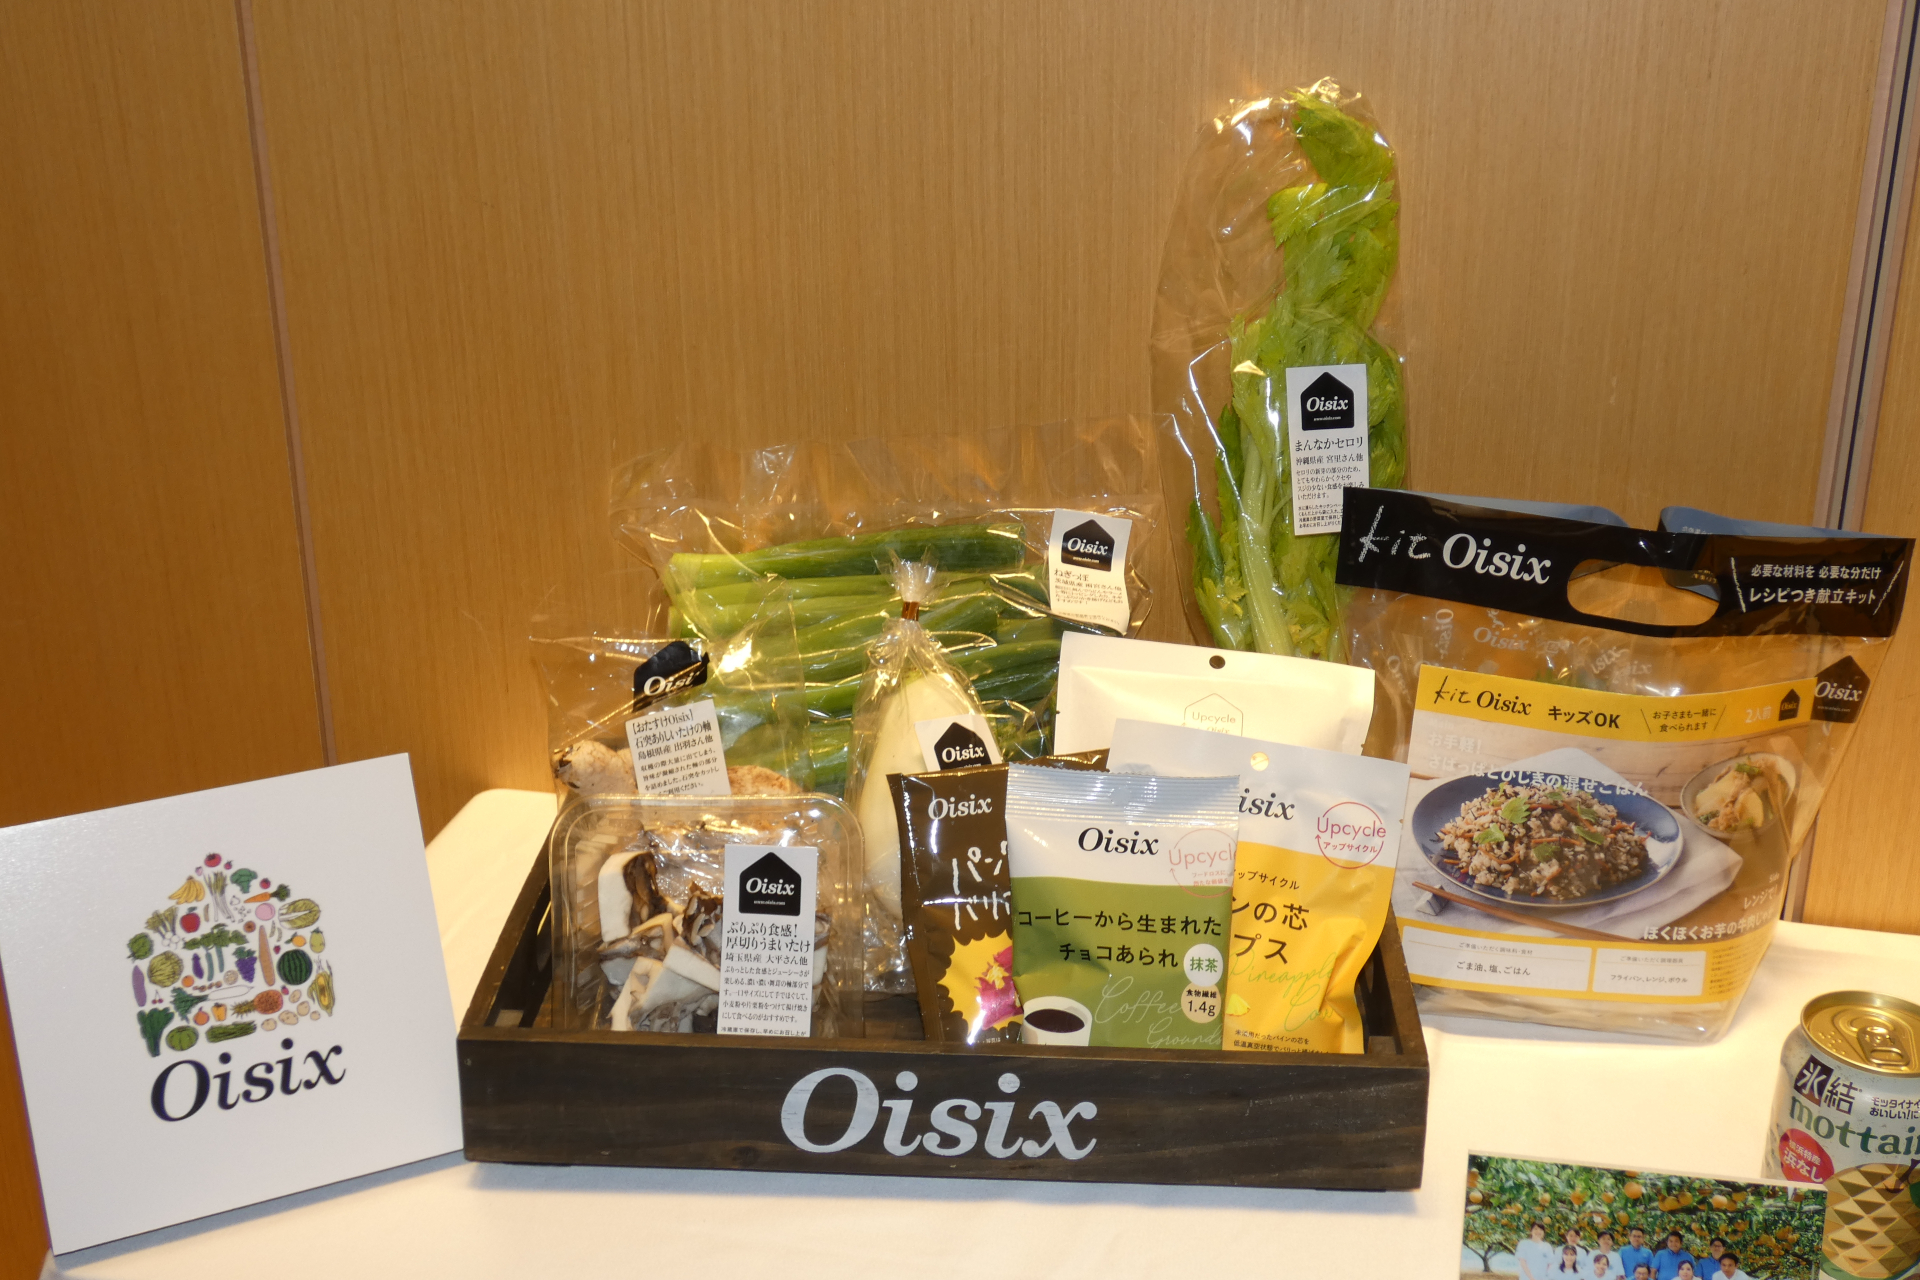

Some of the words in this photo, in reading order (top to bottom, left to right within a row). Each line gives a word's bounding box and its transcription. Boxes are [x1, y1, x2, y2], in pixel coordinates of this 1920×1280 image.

[1306, 396, 1349, 411] Oisix
[1295, 437, 1363, 452] まんなかセロリ
[1296, 455, 1324, 466] 沖縄県産
[1326, 453, 1364, 464] 宮里さん他
[1067, 537, 1109, 556] Oisix
[1442, 533, 1552, 584] Oisix
[1751, 564, 1815, 578] 必要な材料を
[1818, 565, 1882, 580] 必要な分だけ
[1749, 587, 1877, 605] レシピつき献立キット
[1473, 626, 1529, 651] Oisix
[1815, 681, 1863, 702] Oisix
[1192, 711, 1236, 725] Upcycle
[1476, 690, 1532, 716] Oisix
[1548, 705, 1622, 729] キッズOK
[1652, 708, 1717, 720] お子さまも一緒に
[1744, 705, 1773, 724] 2人前
[635, 720, 712, 749] 石突ありしいたけの軸
[1659, 721, 1709, 733] 食べられます
[637, 745, 672, 761] 島根県産
[674, 734, 714, 752] 出羽さん他
[941, 743, 985, 764] Oisix
[928, 793, 993, 820] Oisix
[1238, 788, 1296, 821] isix
[1316, 816, 1387, 839] Upcycle
[1078, 827, 1159, 855] Oisix
[1323, 840, 1378, 854] アップサイクル
[1168, 842, 1237, 870] Upcycl
[745, 877, 795, 896] Oisix
[1018, 908, 1222, 936] コーヒーから生まれた
[726, 935, 811, 953] 厚切りうまいたけ
[1234, 933, 1288, 965] プス
[1459, 942, 1533, 955] ご準備いただく調味料・食材
[725, 952, 762, 964] 埼玉県産
[765, 954, 809, 966] 大平さん他
[1059, 943, 1179, 968] チョコあられ
[1189, 956, 1219, 973] 抹茶
[1456, 961, 1531, 976] ごま油、塩、ごはん
[1610, 974, 1688, 983] フライパン、レンジ、ボウル
[1094, 976, 1182, 1024] Coffee
[1186, 989, 1218, 999] 食物繊維
[722, 1000, 808, 1012] 小麦粉や片栗粉をつけて揚げ焼き
[1187, 1000, 1216, 1017] 1.4g
[722, 1011, 798, 1023] にして食べるのがおすすめです。
[1235, 1029, 1310, 1045] 未活用だったパインの芯を
[150, 1037, 346, 1122] Oisix
[1796, 1062, 1858, 1115] 氷結
[780, 1067, 1098, 1160] Oisix
[1788, 1138, 1821, 1166] 横浜特産
[1784, 1147, 1824, 1183] 浜なし
